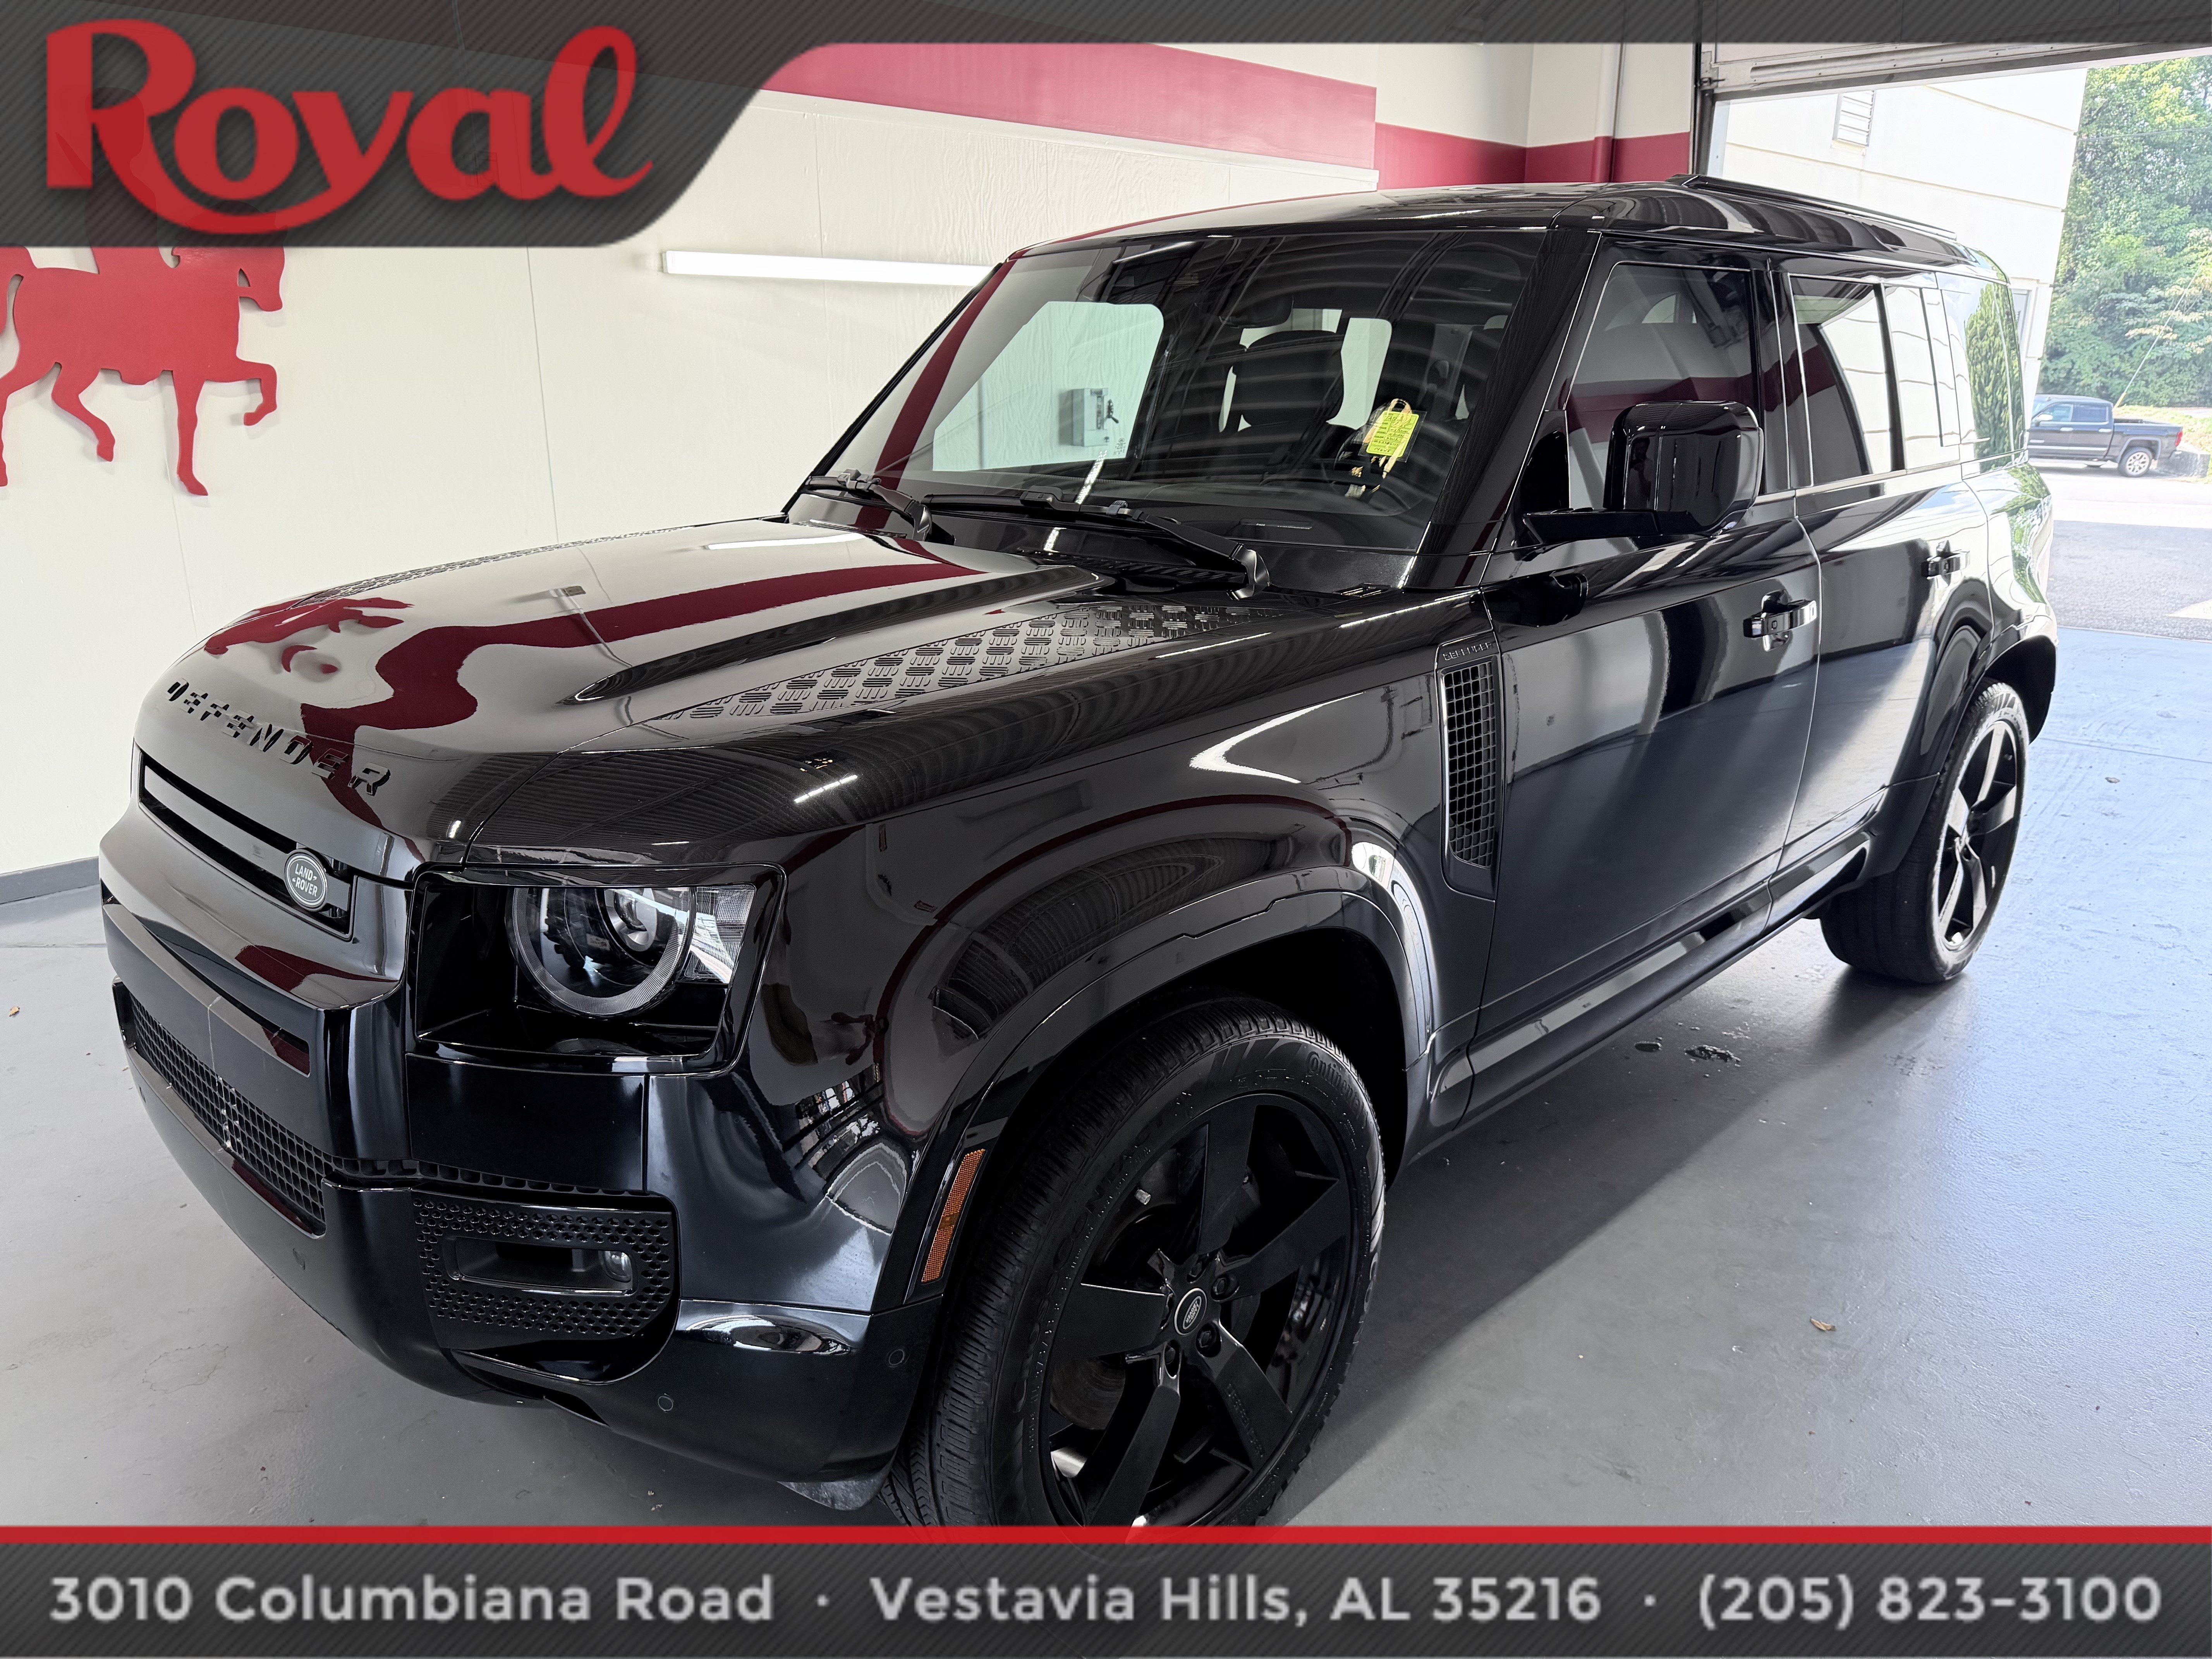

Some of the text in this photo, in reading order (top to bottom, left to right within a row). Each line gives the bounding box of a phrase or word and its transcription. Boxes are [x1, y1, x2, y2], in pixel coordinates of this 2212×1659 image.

[1443, 642, 1494, 660] DEFENDER
[166, 678, 391, 796] DEFENDER
[295, 863, 313, 881] LAND
[295, 877, 318, 897] ROVER
